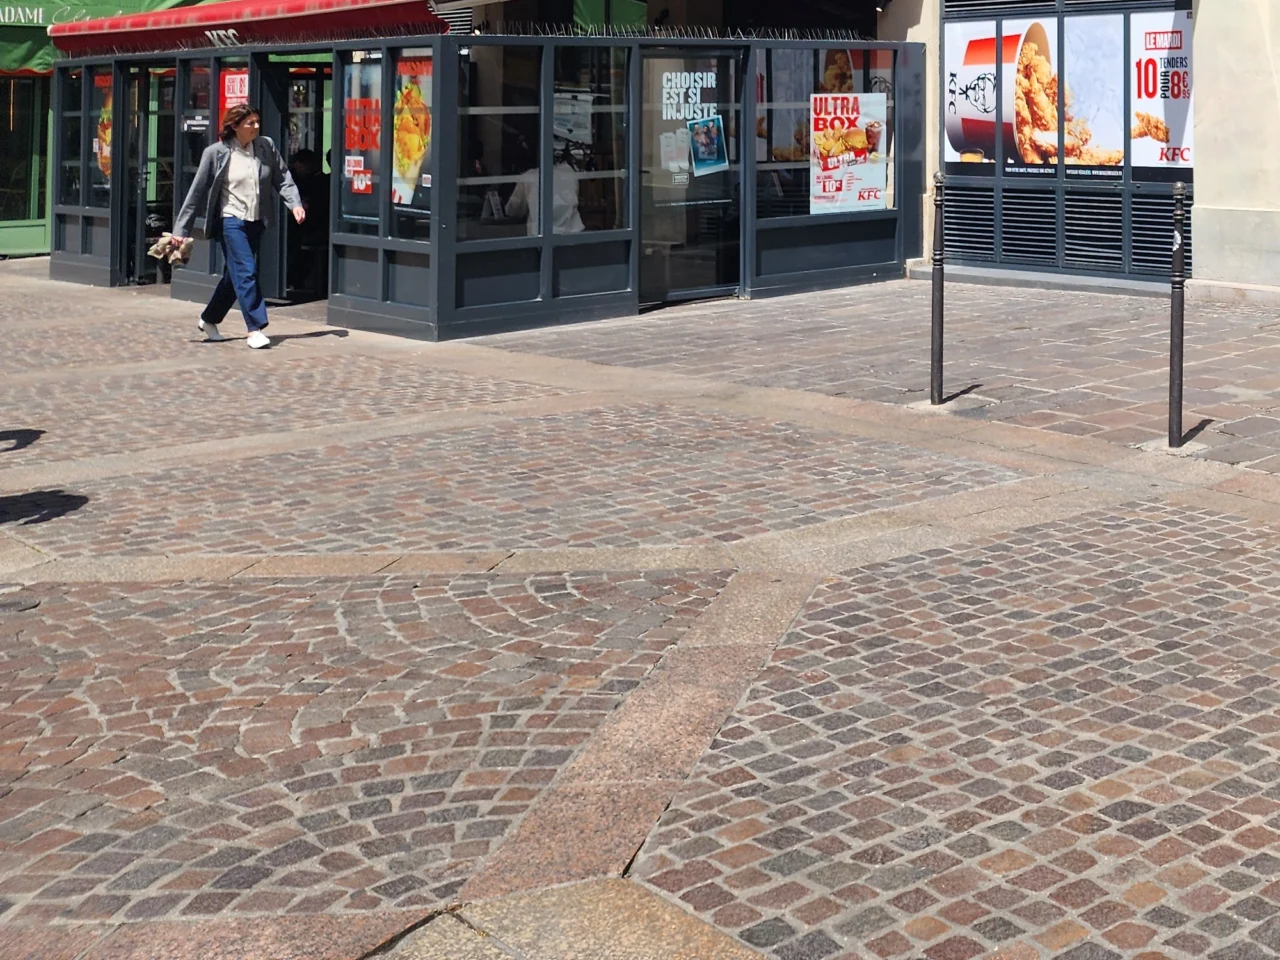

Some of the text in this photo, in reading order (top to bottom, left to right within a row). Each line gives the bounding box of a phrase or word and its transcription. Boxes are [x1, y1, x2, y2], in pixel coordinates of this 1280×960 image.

[204, 28, 239, 49] KFC
[1146, 30, 1182, 49] LE MARDI
[662, 71, 717, 88] CHOISIR
[1135, 56, 1188, 99] 10 TENDERS
[1160, 70, 1170, 99] POUR
[662, 87, 701, 105] EST SI
[948, 70, 957, 116] KFC
[662, 103, 718, 121] INJUSTE
[813, 96, 860, 117] ULTRA
[813, 116, 859, 132] BOX
[345, 127, 381, 151] BOX
[1159, 146, 1190, 162] KFC
[857, 189, 882, 201] KFC
